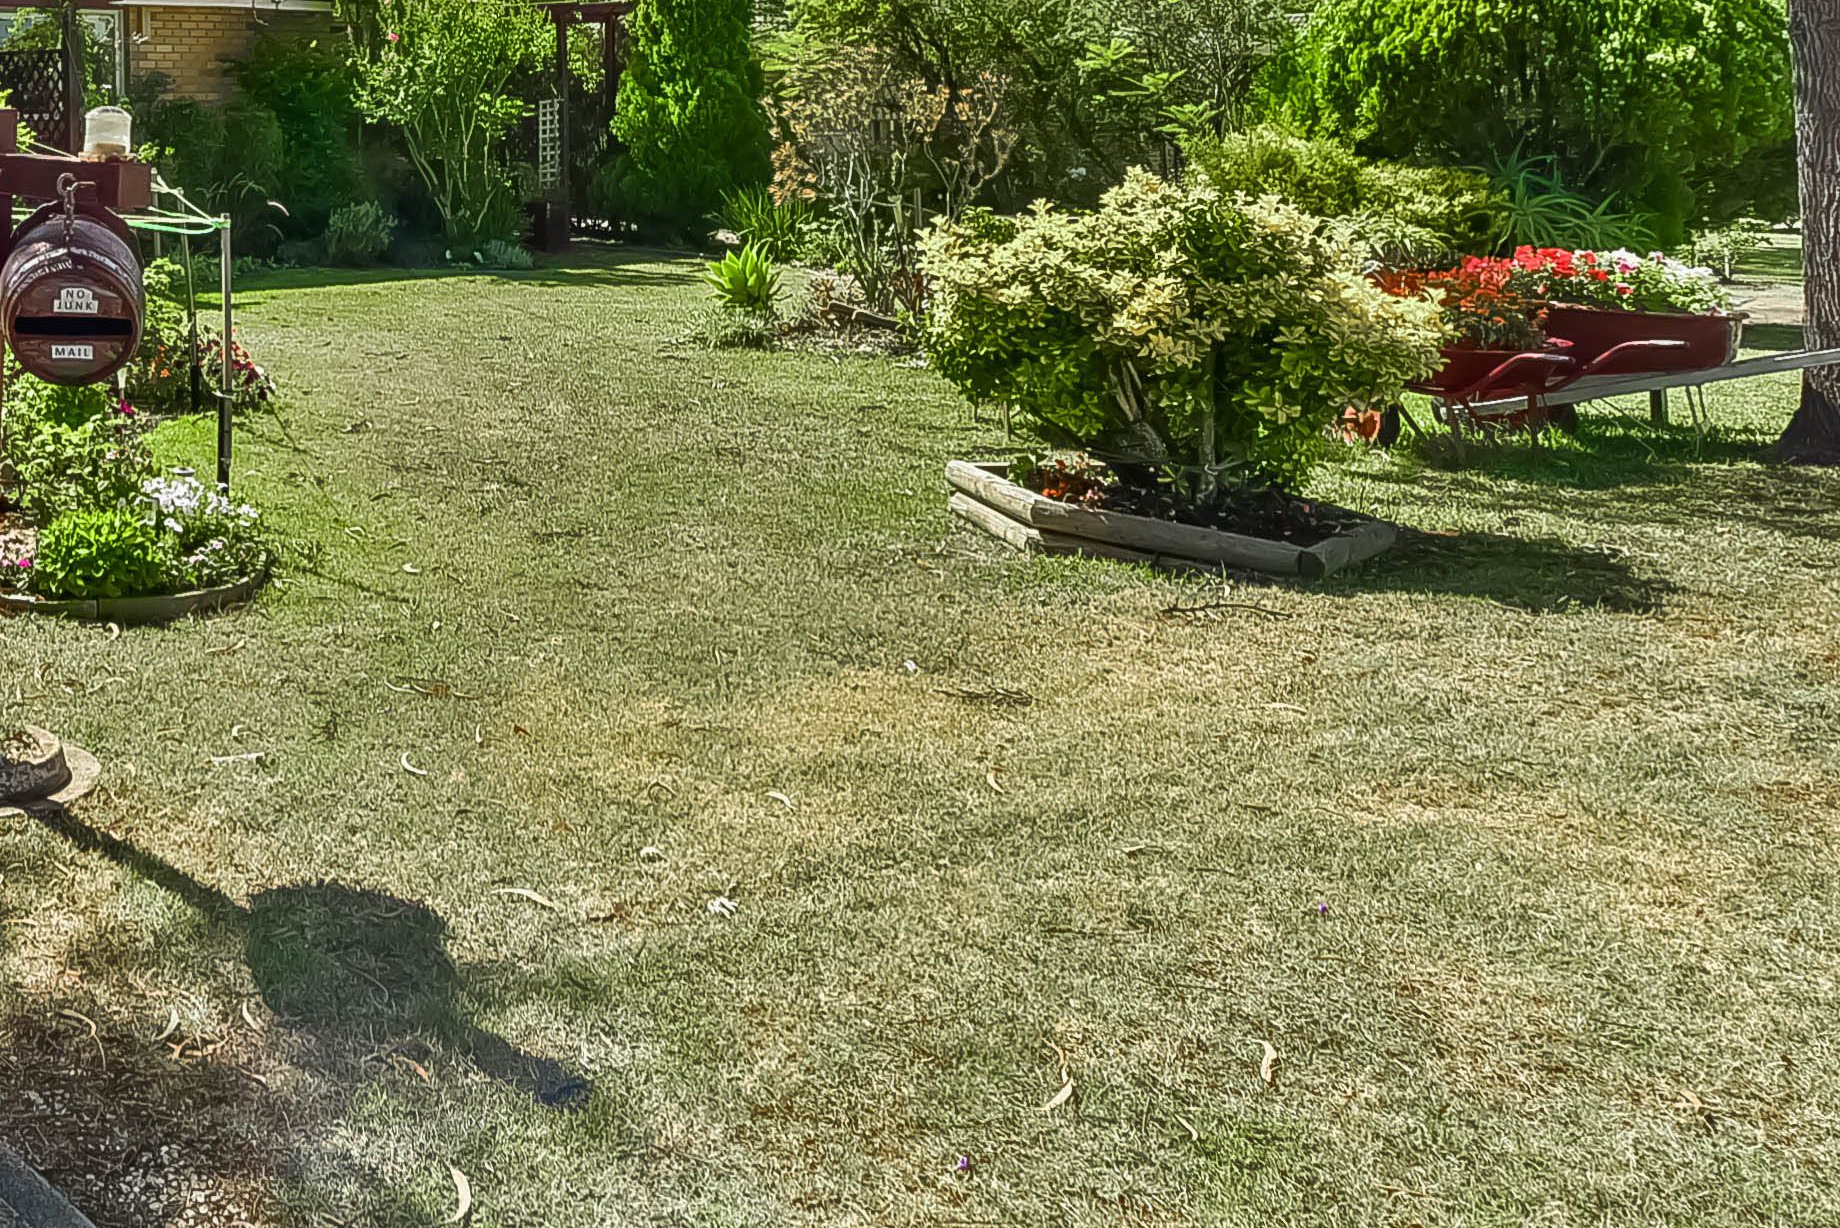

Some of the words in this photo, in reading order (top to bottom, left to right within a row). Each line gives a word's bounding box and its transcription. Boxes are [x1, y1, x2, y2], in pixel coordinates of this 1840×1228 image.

[65, 289, 85, 299] NO
[57, 300, 93, 310] JUNK
[54, 347, 90, 357] MAIL
